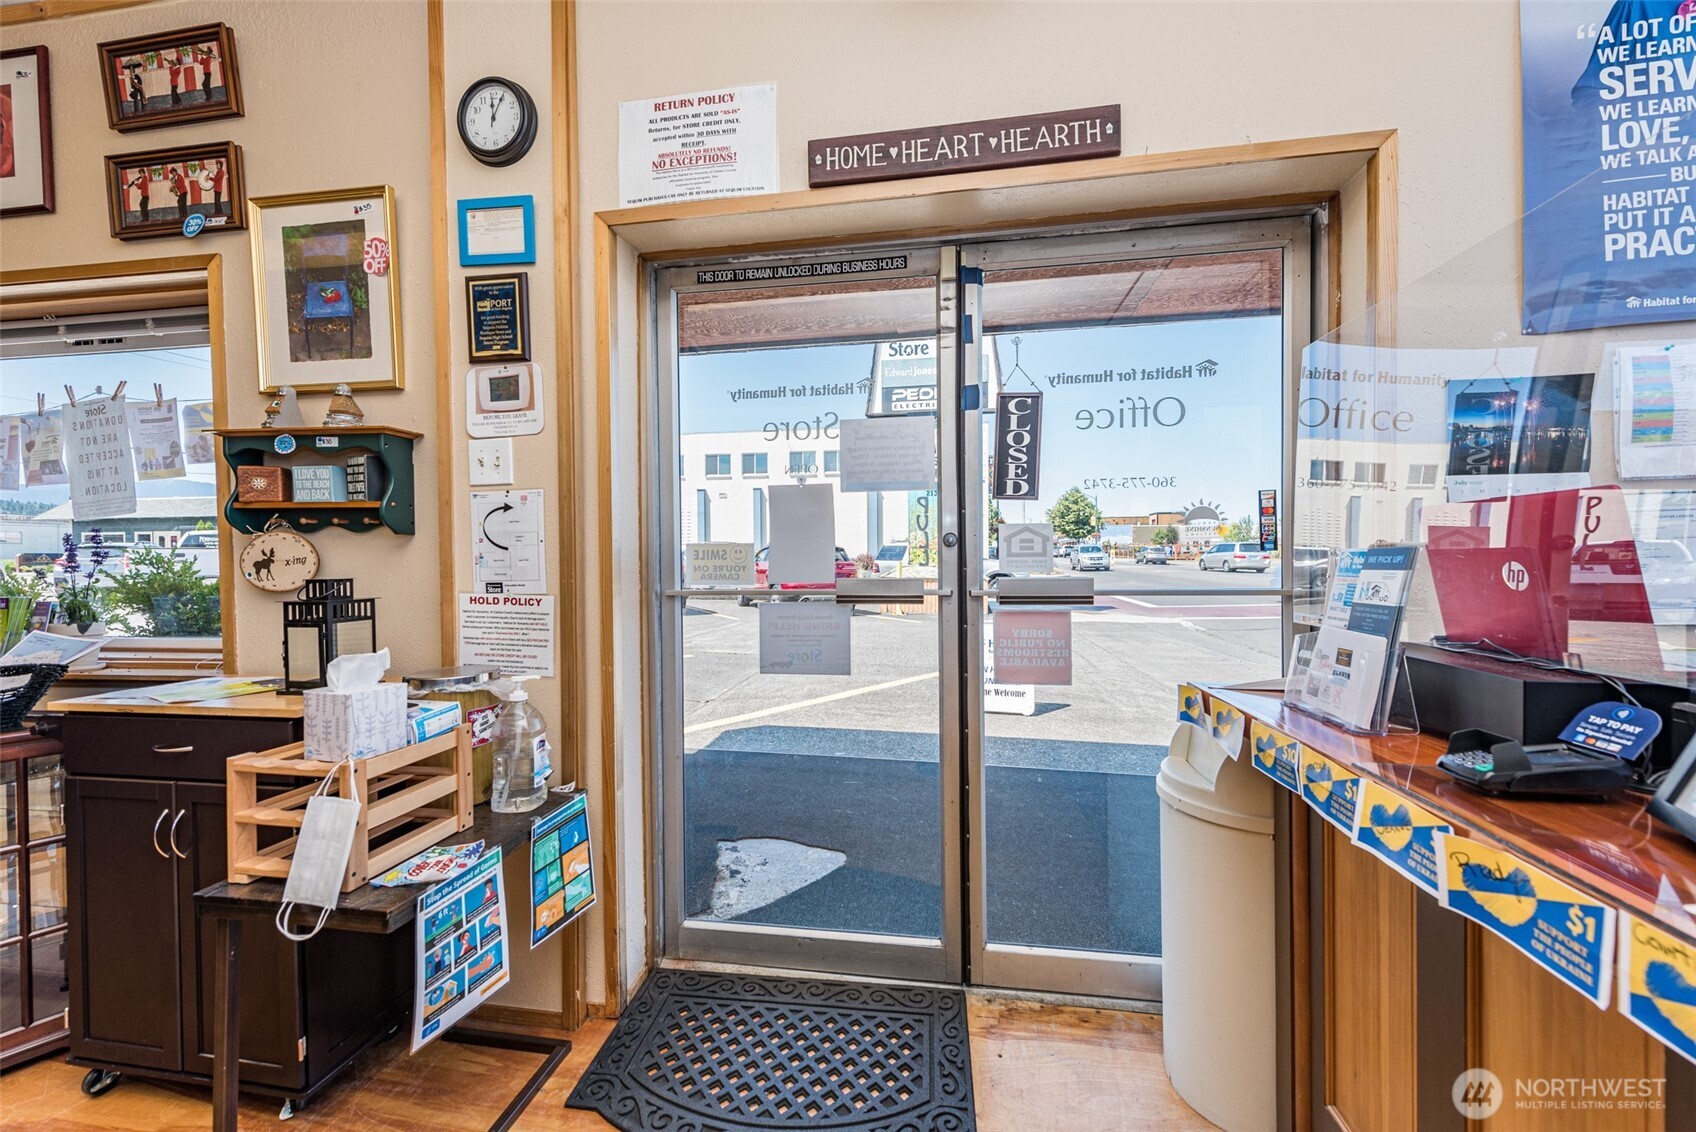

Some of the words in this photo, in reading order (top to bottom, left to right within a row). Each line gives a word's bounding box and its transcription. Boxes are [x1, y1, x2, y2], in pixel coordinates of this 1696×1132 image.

[1621, 17, 1663, 41] LOT
[1597, 45, 1630, 64] WE
[654, 97, 694, 112] RETURN
[697, 92, 736, 107] POLICY
[660, 114, 690, 123] PRODUCTS
[1599, 103, 1632, 121] WE
[682, 121, 700, 129] STORE
[702, 119, 723, 127] CREDIT
[1601, 116, 1689, 151] LOVE,
[652, 134, 676, 143] accepted
[678, 131, 695, 139] within
[705, 129, 720, 137] DAYS
[826, 143, 887, 170] HOME
[901, 133, 984, 163] HEART
[1000, 119, 1102, 154] HEARTH
[652, 159, 666, 170] NO
[669, 152, 737, 168] EXCEPTIONS!
[658, 149, 692, 159] ABSOLUTELY
[703, 145, 732, 154] REFUNDS!
[1600, 152, 1632, 170] WE
[1636, 146, 1682, 165] TALK
[1602, 186, 1690, 212] HABITAT
[1604, 209, 1647, 231] PUT
[1653, 207, 1674, 226] IT
[186, 225, 200, 233] OFF
[363, 240, 390, 259] 50%
[363, 258, 387, 275] OFF
[698, 272, 714, 283] THIS
[715, 270, 734, 282] DOOR
[735, 269, 745, 280] TO
[746, 267, 773, 279] REMAIN
[775, 265, 812, 278] UNLOCKED
[814, 262, 841, 275] DURING
[843, 259, 878, 272] BUSINESS
[879, 257, 905, 269] HOURS
[490, 298, 513, 308] PORT
[1643, 297, 1680, 308] Habitat
[888, 342, 929, 357] Store
[885, 366, 913, 378] Edward
[1352, 370, 1375, 383] for
[1377, 371, 1451, 389] Humanity
[1299, 397, 1414, 432] Office
[1003, 397, 1032, 497] CLOSED
[299, 468, 316, 479] LOVE
[316, 468, 330, 479] YOU
[295, 480, 302, 488] TO
[302, 480, 313, 488] THE
[296, 490, 311, 500] AND
[311, 489, 331, 500] BACK
[1367, 555, 1376, 564] WE
[1378, 555, 1393, 564] PICK
[1393, 554, 1405, 564] UP!
[1507, 560, 1525, 590] hp
[469, 596, 500, 605] HOLD
[503, 597, 542, 607] POLICY
[994, 688, 1027, 698] Welcome
[1588, 714, 1609, 725] TAP
[1606, 720, 1621, 729] TO
[1620, 723, 1644, 734] PAY
[426, 892, 441, 906] Stop
[442, 886, 452, 895] the
[453, 872, 473, 889] Spread
[474, 866, 480, 875] of
[480, 857, 497, 870] Germs
[438, 910, 443, 919] 6
[1565, 904, 1596, 943] $1
[1537, 919, 1590, 957] SUPPORT
[1533, 928, 1553, 947] THE
[1553, 941, 1593, 973] PEOPLE
[1531, 939, 1545, 953] OF
[1545, 947, 1594, 988] UKRAINE
